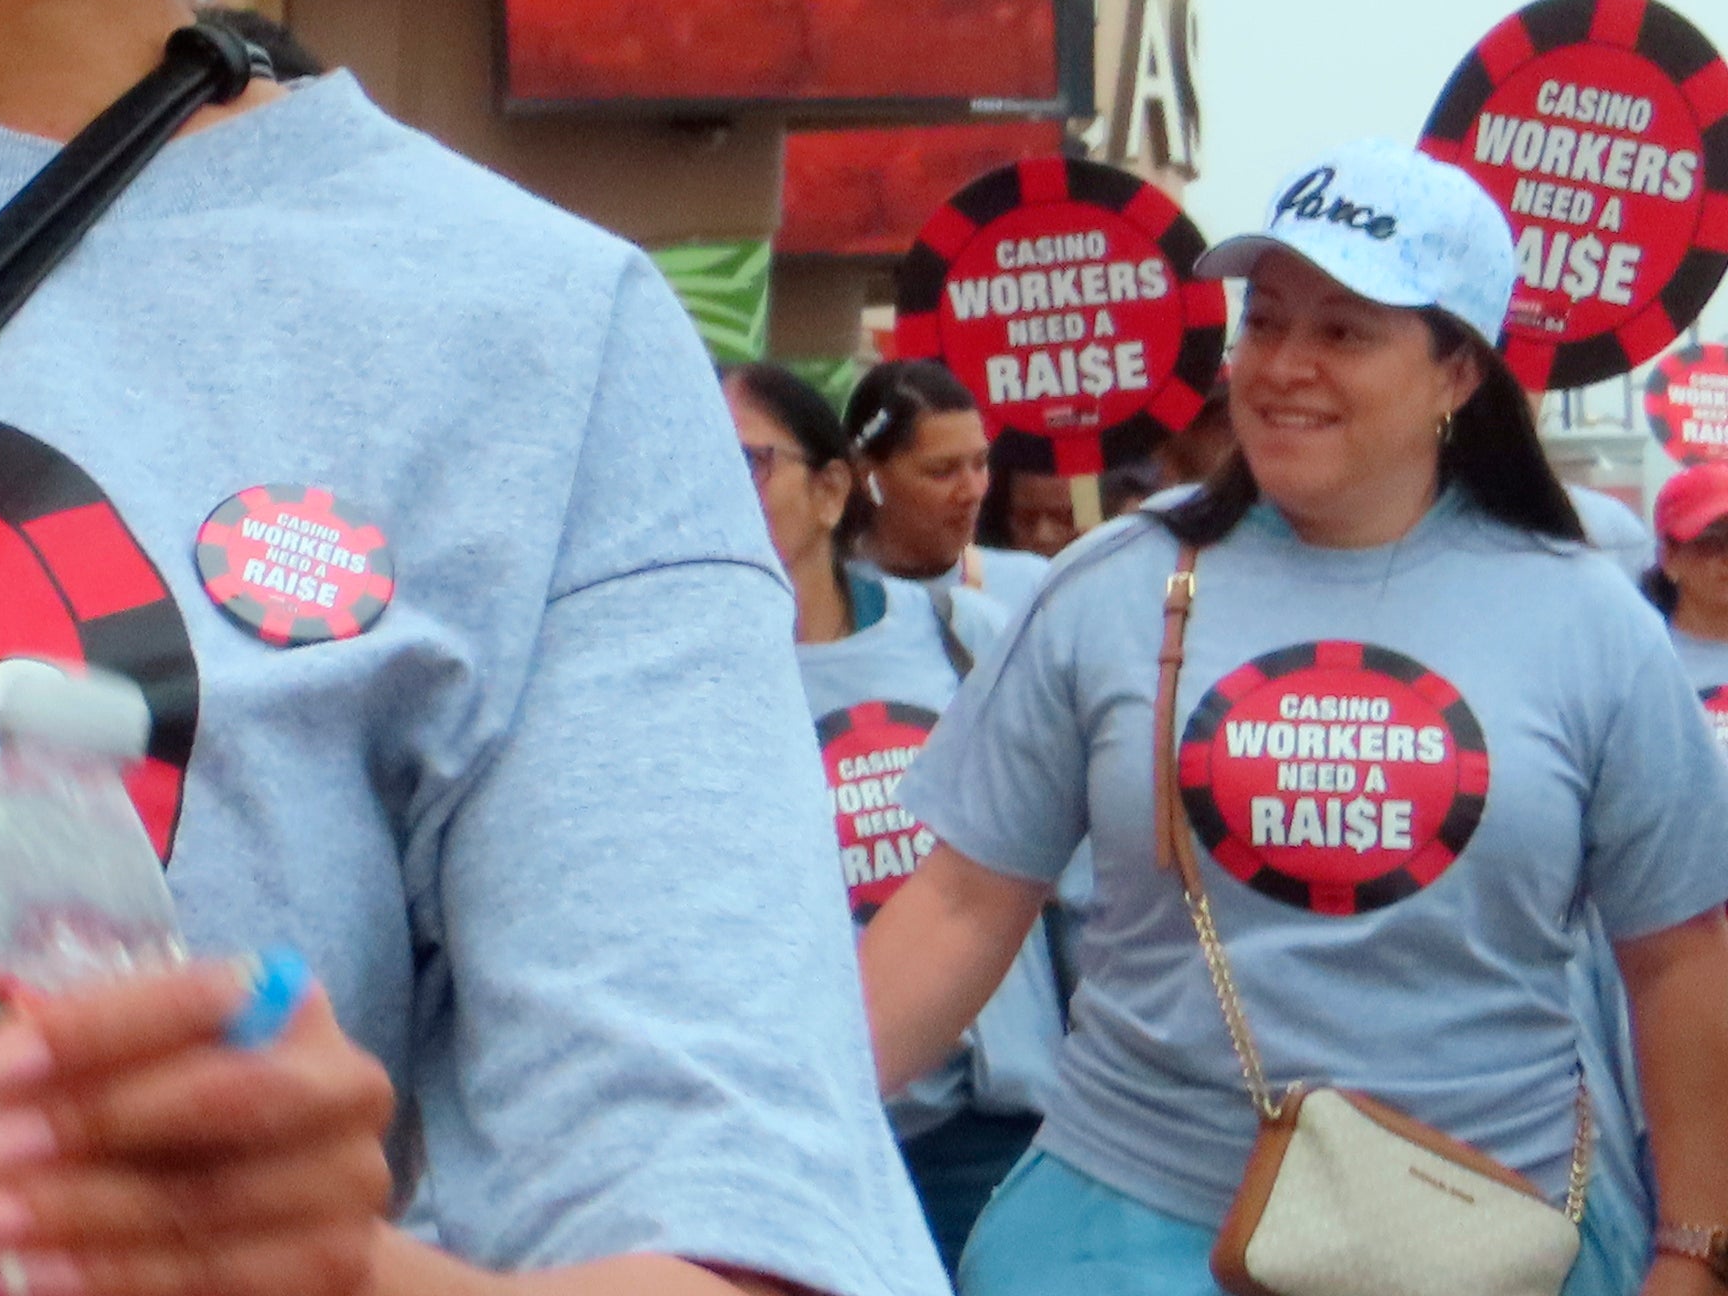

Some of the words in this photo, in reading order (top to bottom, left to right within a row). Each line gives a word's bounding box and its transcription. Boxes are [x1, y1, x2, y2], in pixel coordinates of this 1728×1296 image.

[1536, 79, 1653, 133] CASINO
[1473, 111, 1698, 202] WORKERS
[1510, 177, 1593, 225] NEED
[1597, 195, 1622, 232] A
[996, 229, 1107, 269] CASINO
[1514, 225, 1642, 305] AI$E
[948, 258, 1168, 320] WORKERS
[1007, 312, 1086, 347] NEED
[1094, 309, 1115, 337] A
[241, 518, 367, 574] WORKERS
[276, 512, 341, 543] CASINO
[265, 546, 311, 573] NEED
[314, 565, 327, 578] A
[1280, 694, 1391, 722] CASINO
[1226, 721, 1447, 764] WORKERS
[1277, 762, 1356, 792] NEED
[1364, 765, 1386, 793] A
[1251, 795, 1413, 854] RAI$E
